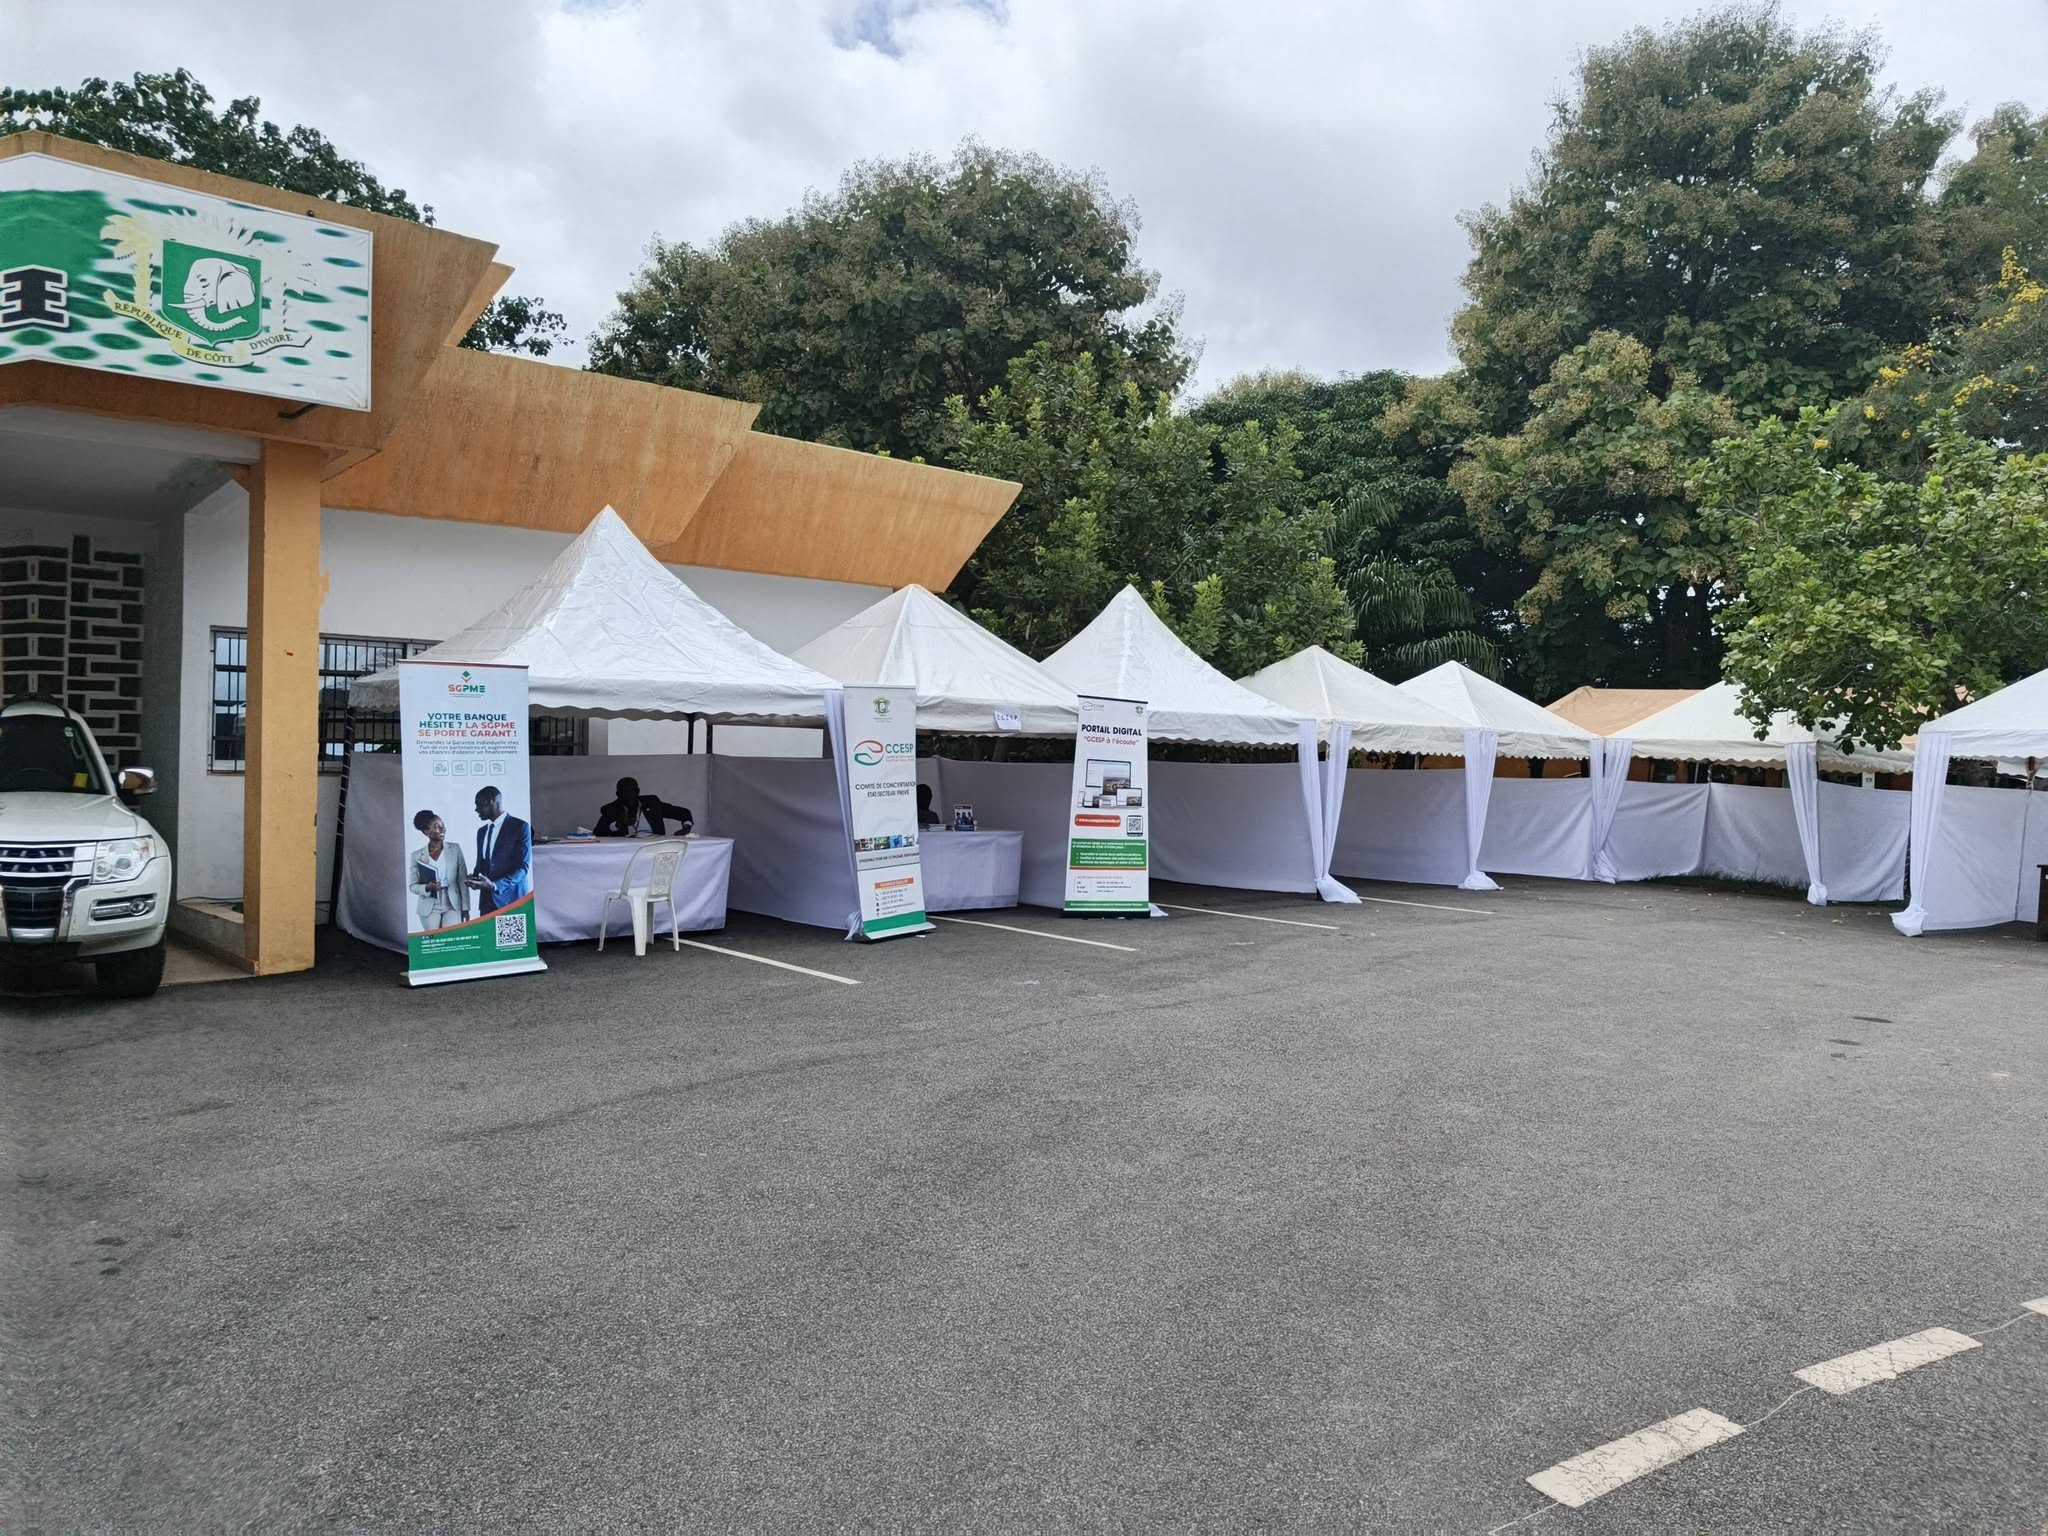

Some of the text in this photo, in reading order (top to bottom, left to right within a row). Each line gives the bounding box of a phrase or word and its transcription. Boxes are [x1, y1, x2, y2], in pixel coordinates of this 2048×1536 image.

[114, 301, 293, 364] RÉPUBLIQUE DE CÔTE D'IVOIRE
[447, 684, 486, 693] SGPME
[427, 712, 507, 722] VOTRE BANQUE
[457, 721, 462, 729] ?
[465, 721, 479, 729] LA
[481, 721, 516, 730] SGPME
[1081, 724, 1143, 736] PORTAIL DIGITAL
[418, 729, 431, 737] SE
[434, 729, 467, 738] PORTE
[470, 729, 511, 738] GARANT
[885, 743, 914, 754] CCESP
